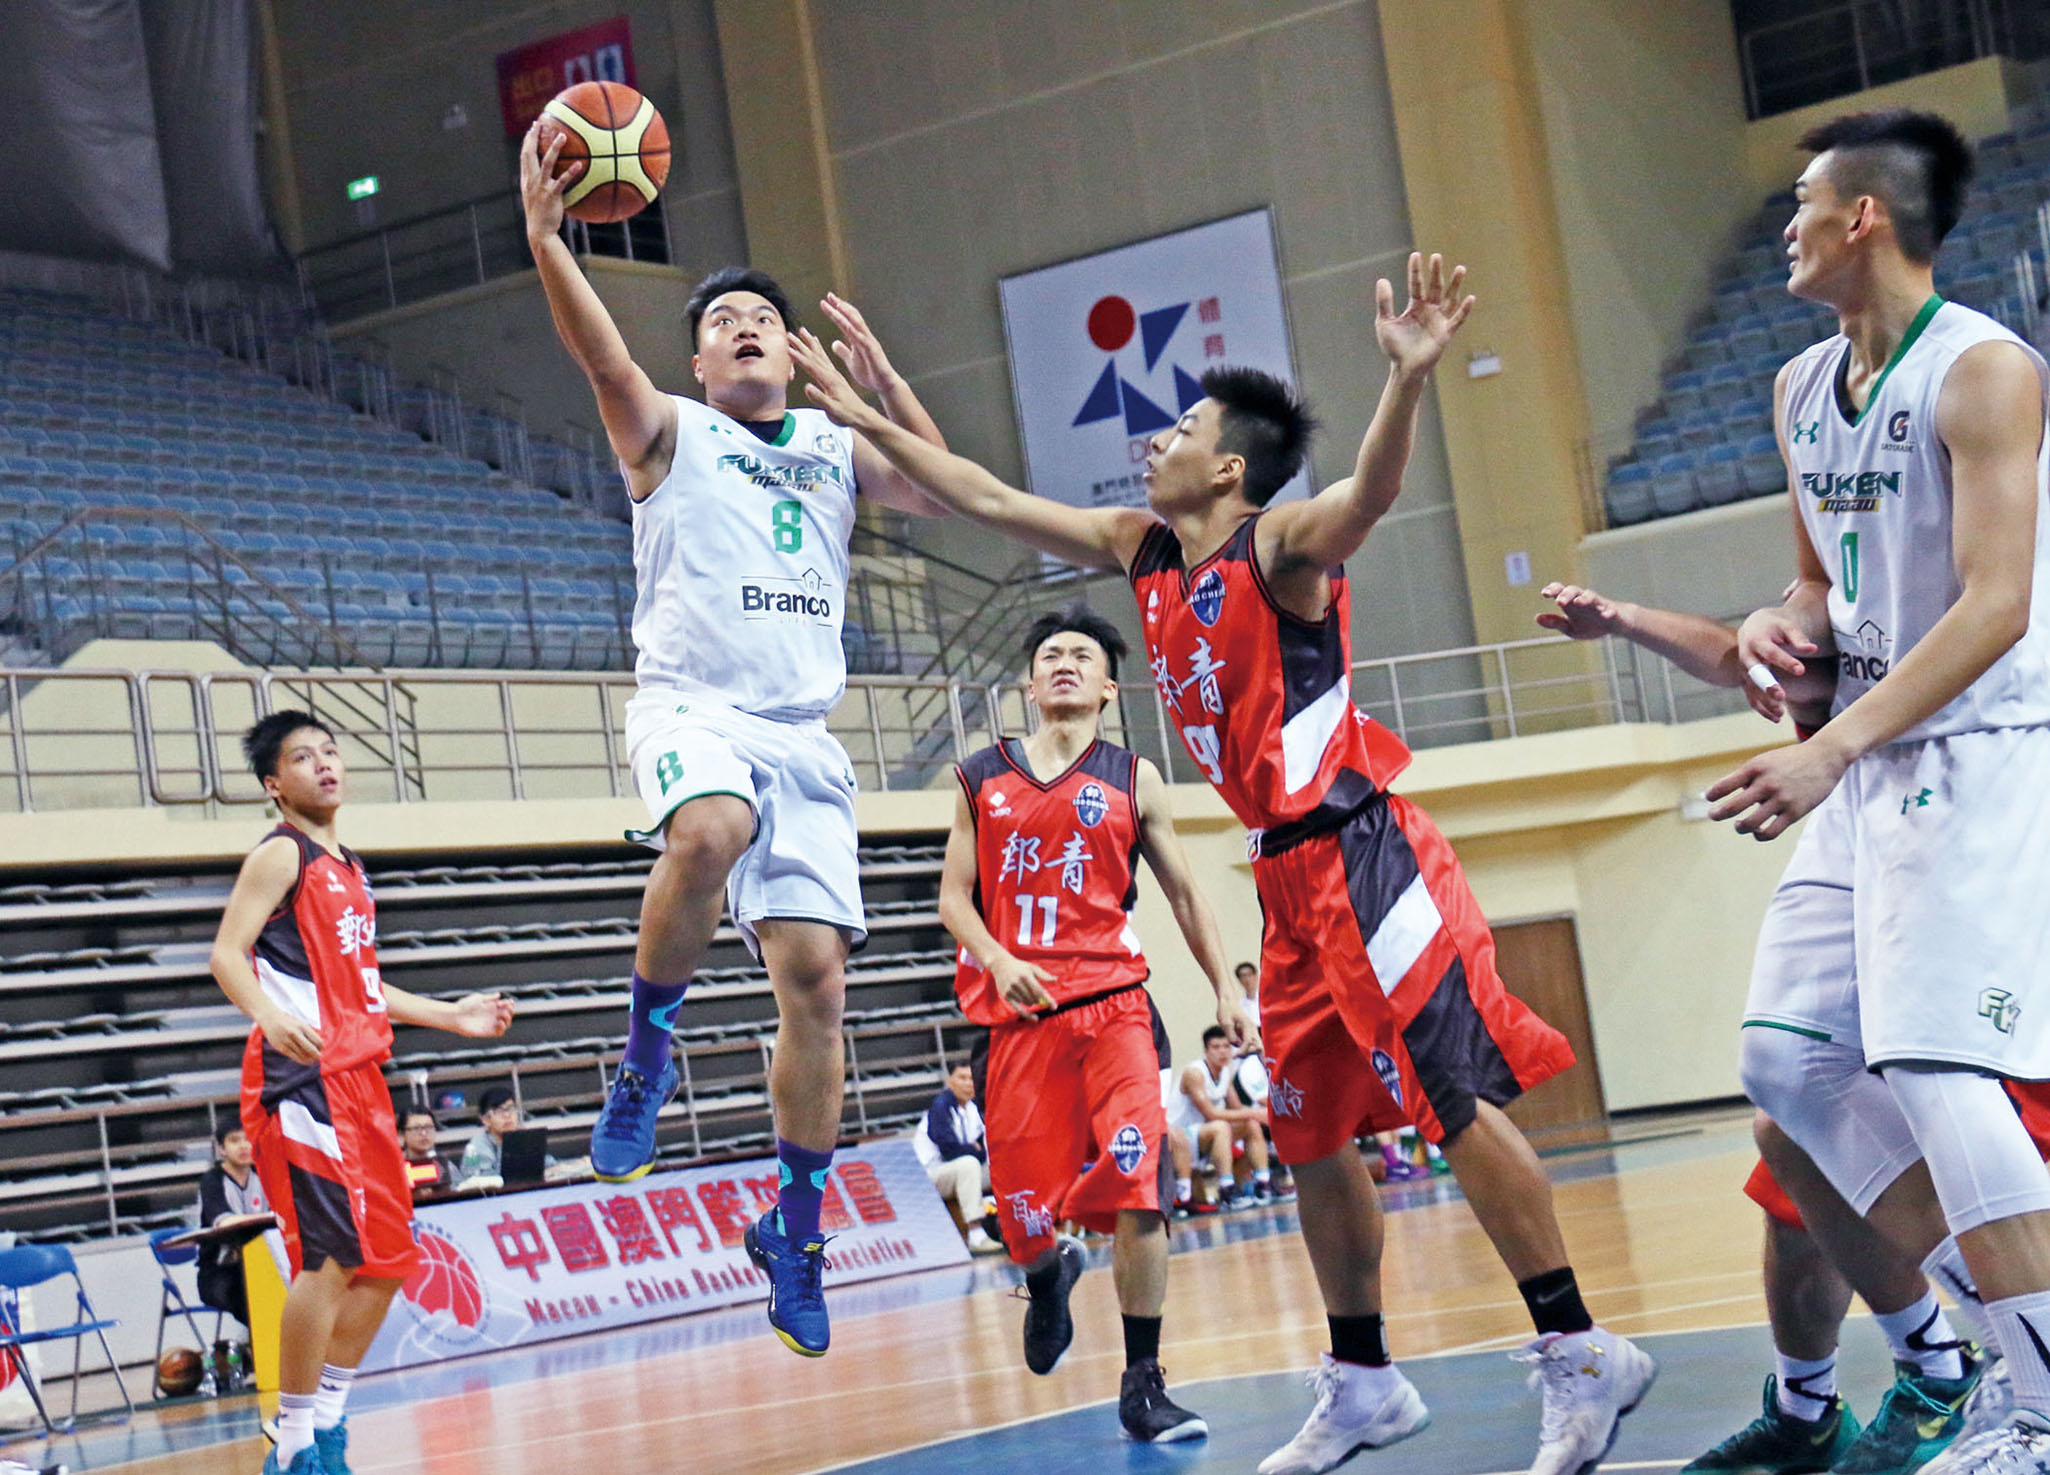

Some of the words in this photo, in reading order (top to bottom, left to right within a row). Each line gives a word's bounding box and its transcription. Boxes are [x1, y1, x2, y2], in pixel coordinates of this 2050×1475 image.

[772, 501, 802, 554] 8
[1841, 532, 1858, 603] 0
[742, 585, 830, 617] Branco
[656, 750, 685, 797] 8
[1183, 724, 1224, 785] 9
[1015, 893, 1059, 947] 11
